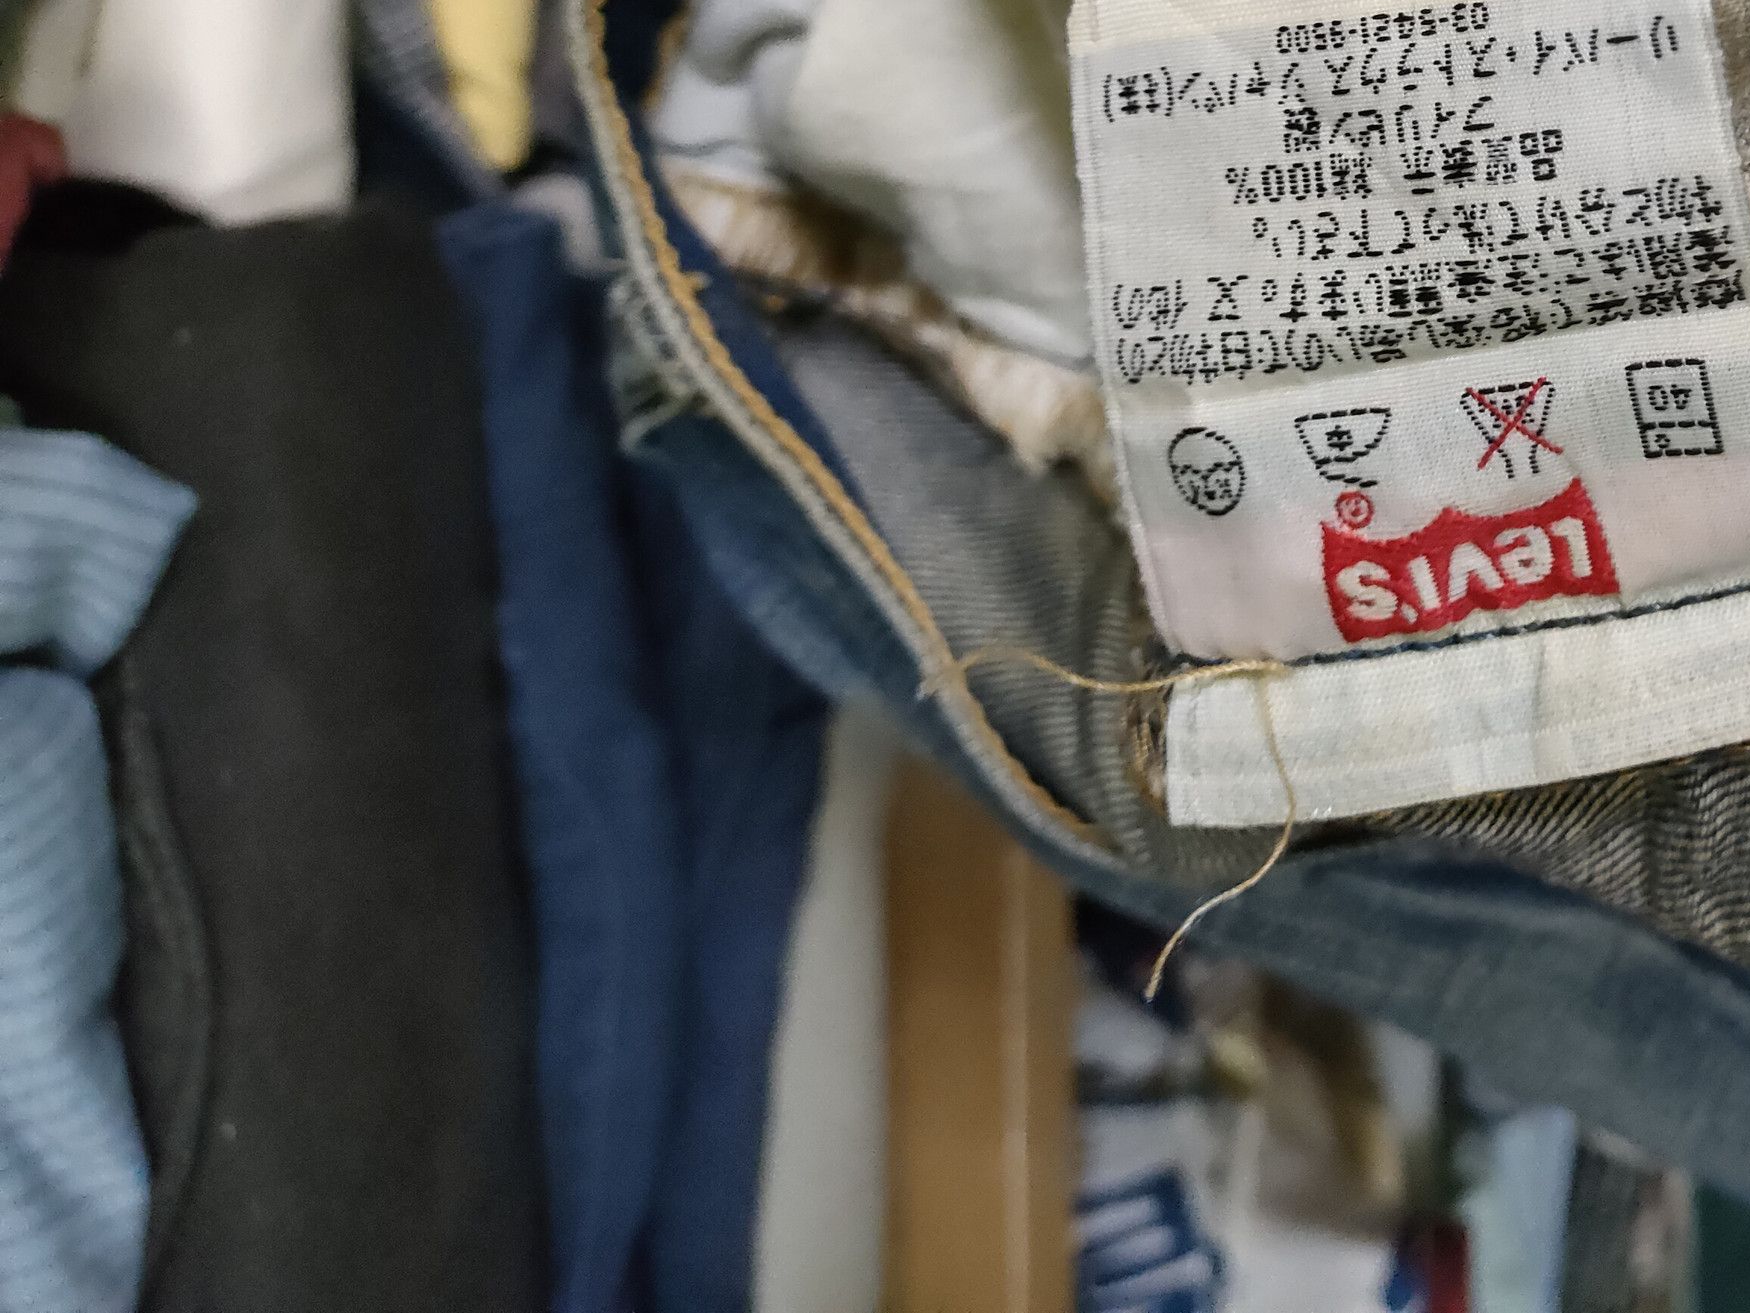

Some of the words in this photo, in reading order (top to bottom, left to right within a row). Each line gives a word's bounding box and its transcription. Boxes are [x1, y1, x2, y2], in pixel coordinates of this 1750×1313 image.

[1283, 94, 1496, 154] フィリピン製
[1401, 128, 1564, 195] 品質表示
